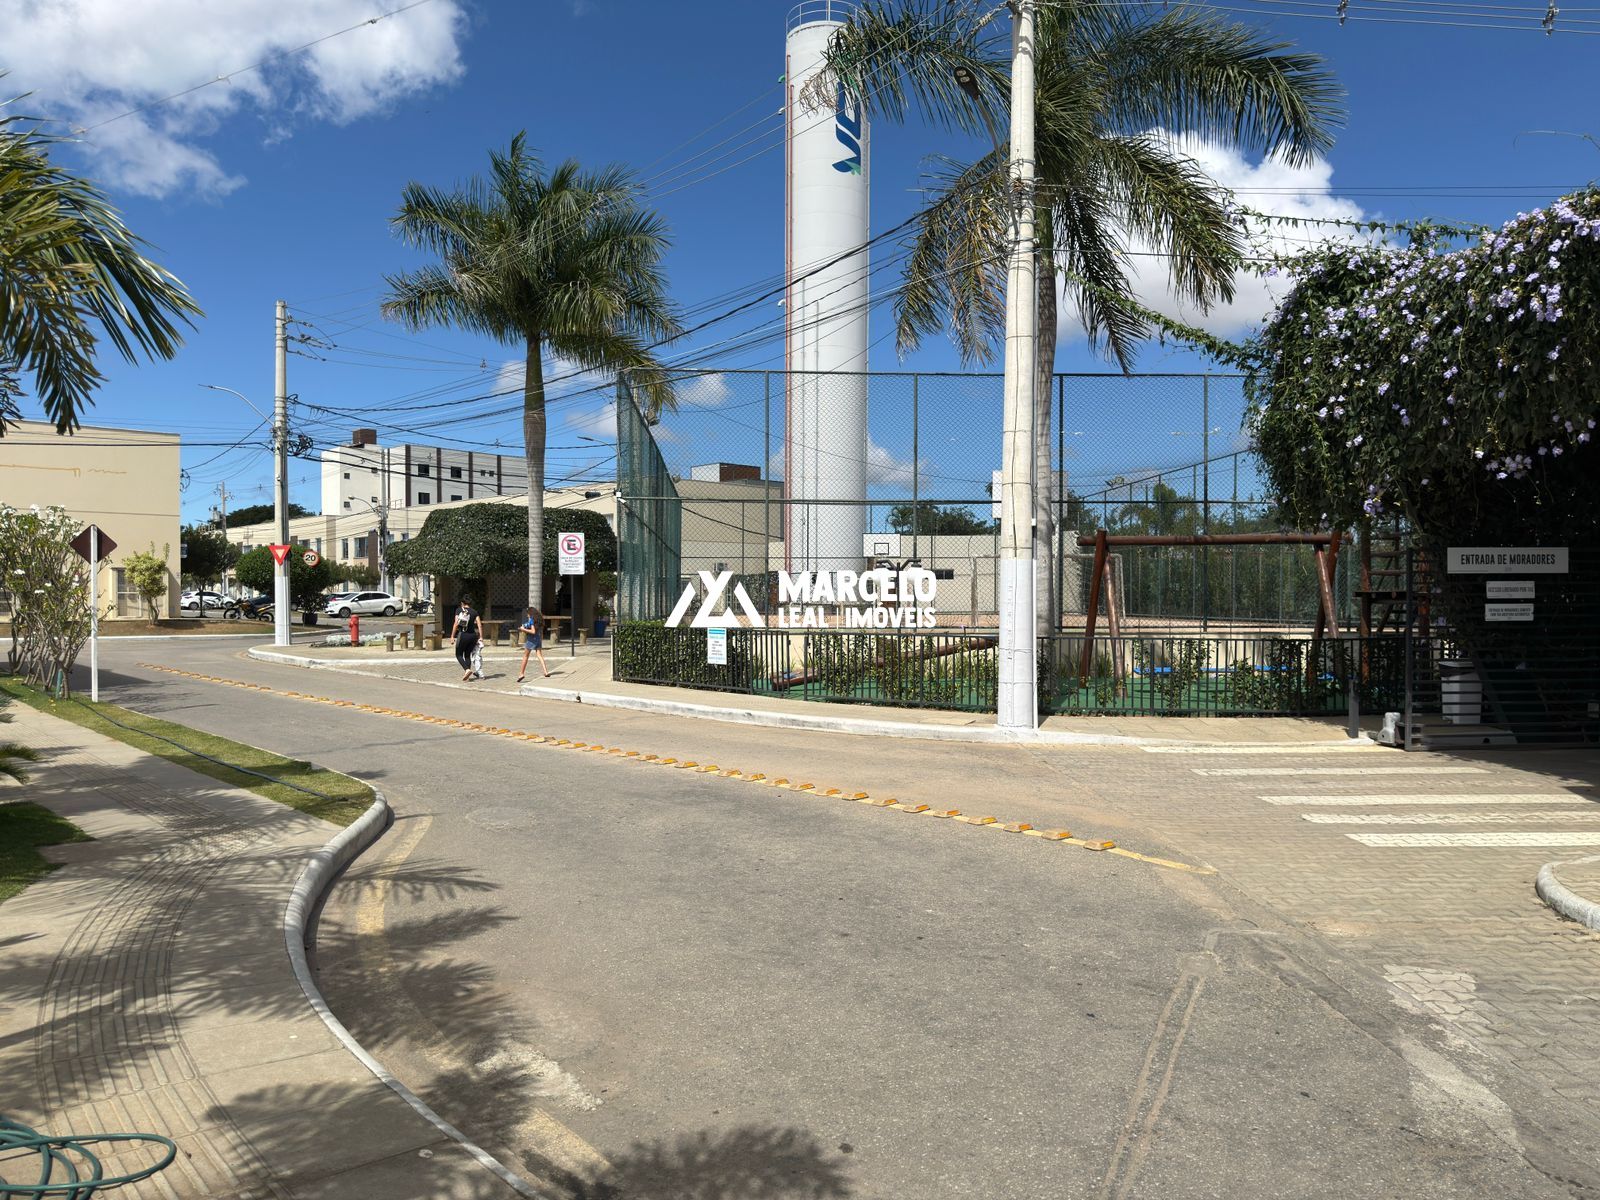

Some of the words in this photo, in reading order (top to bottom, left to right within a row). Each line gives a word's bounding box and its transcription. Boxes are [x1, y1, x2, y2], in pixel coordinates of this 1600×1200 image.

[1460, 554, 1495, 565] ENTRADA
[1497, 554, 1507, 565] DE
[1509, 554, 1556, 565] MORADORES
